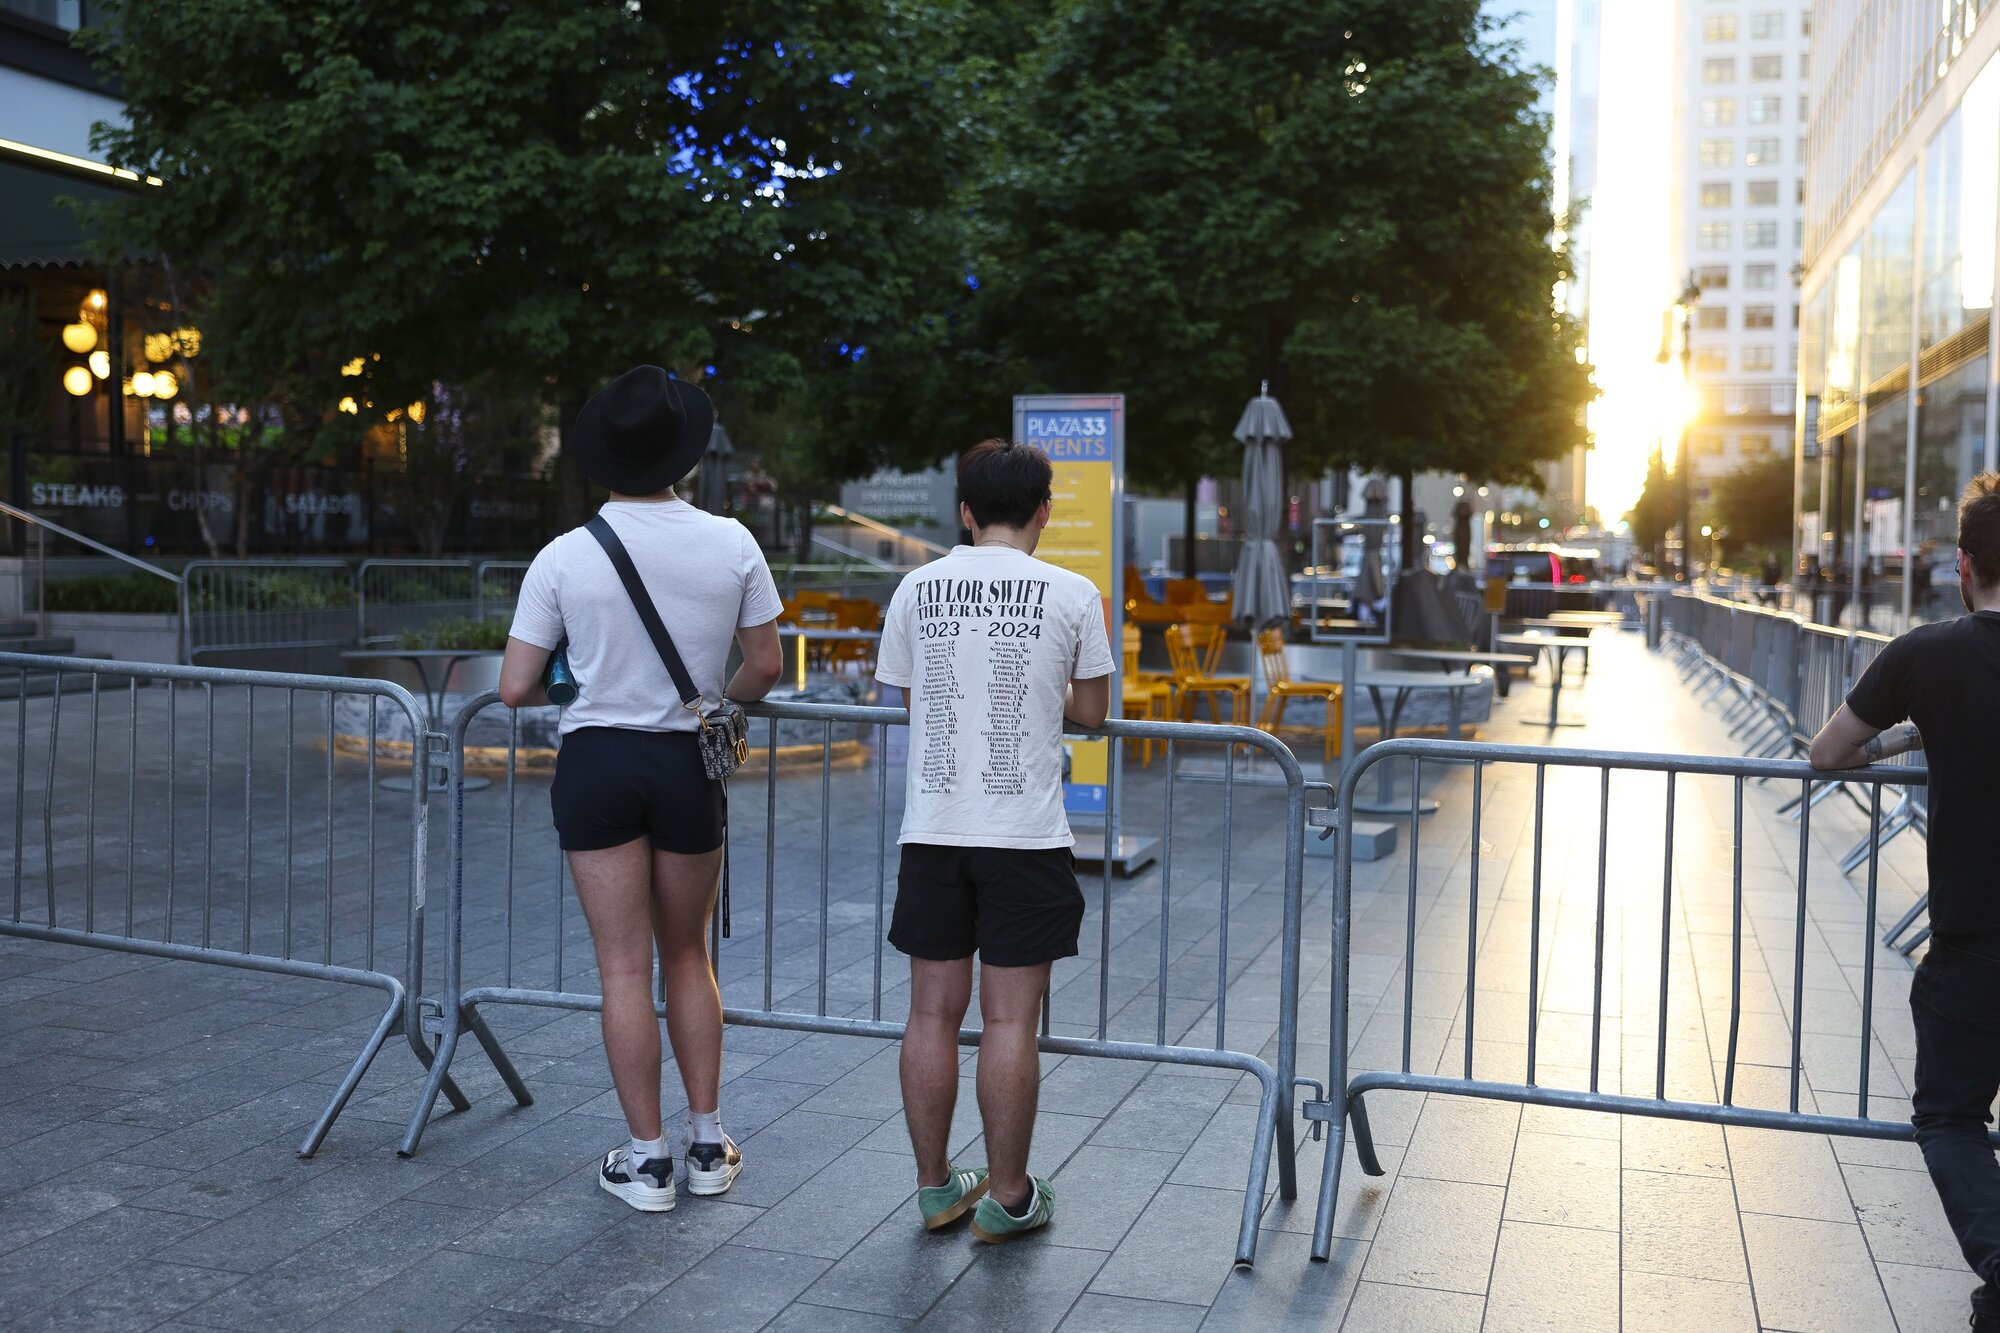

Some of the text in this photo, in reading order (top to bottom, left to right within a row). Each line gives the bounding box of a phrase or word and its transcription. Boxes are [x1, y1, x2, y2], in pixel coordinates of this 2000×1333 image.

[1027, 417, 1107, 436] PLAZA33
[1028, 437, 1106, 456] EVENTS
[31, 483, 122, 507] STEAKS
[167, 489, 233, 512] CHOPS
[916, 579, 1050, 606] TAYLOR SWIFT
[916, 604, 1044, 620] THE ERAS TOUR
[919, 621, 960, 640] 2023
[988, 622, 1041, 640] 2024
